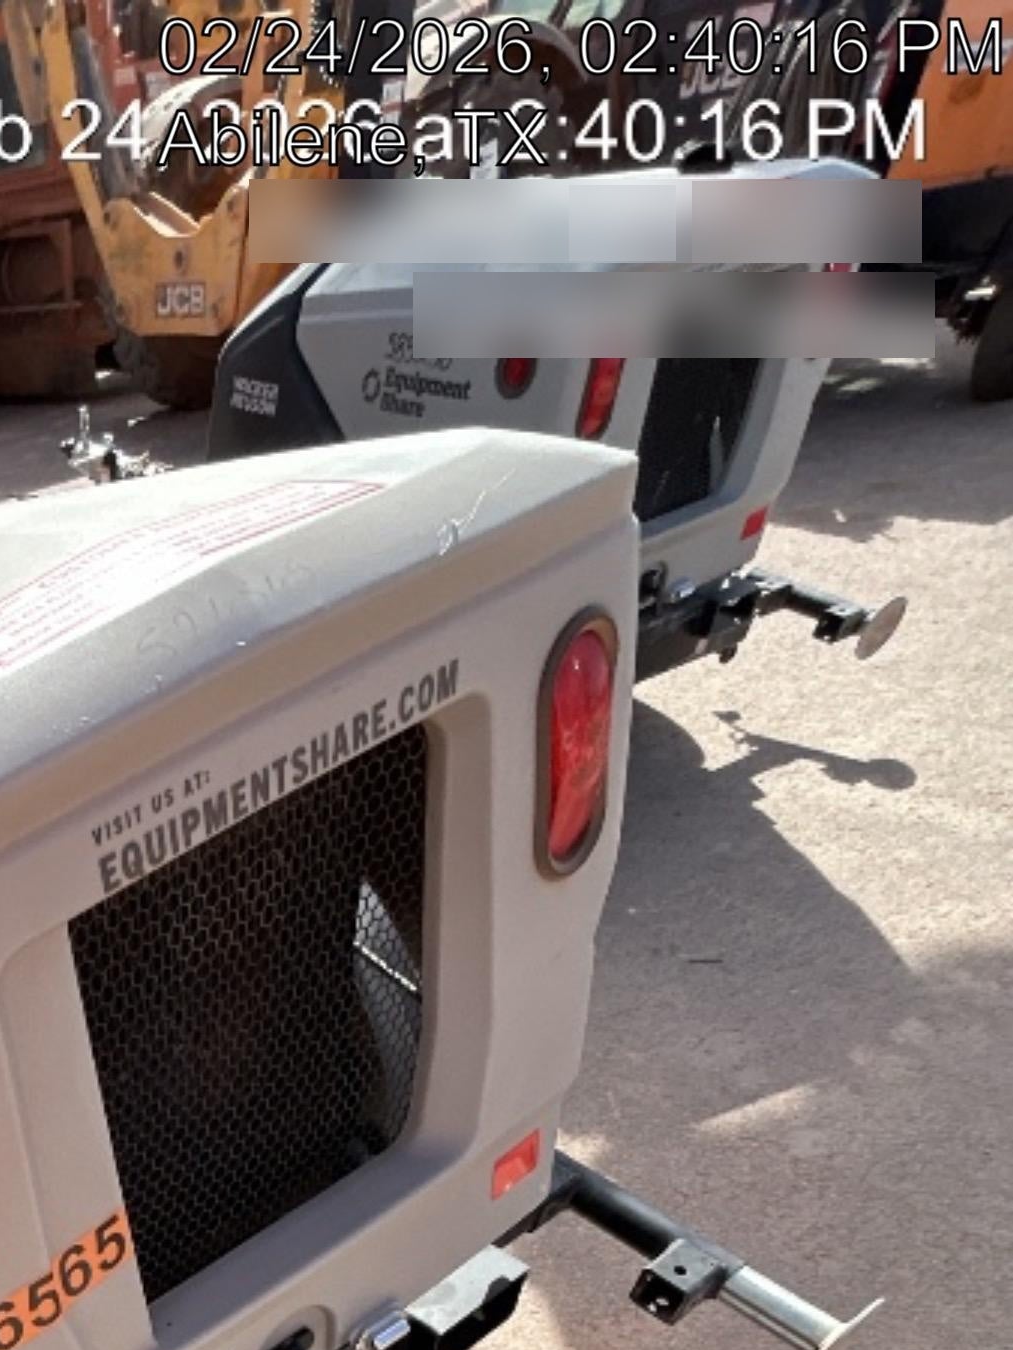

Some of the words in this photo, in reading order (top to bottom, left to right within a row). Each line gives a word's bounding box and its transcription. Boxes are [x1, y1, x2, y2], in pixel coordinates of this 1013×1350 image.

[157, 284, 205, 315] JCB
[385, 366, 472, 400] Equipment
[379, 391, 425, 418] Share
[97, 658, 460, 894] EQUIPMENTSHARE.COM
[91, 804, 142, 847] VISIT
[150, 787, 175, 814] US
[183, 768, 211, 798] AT:
